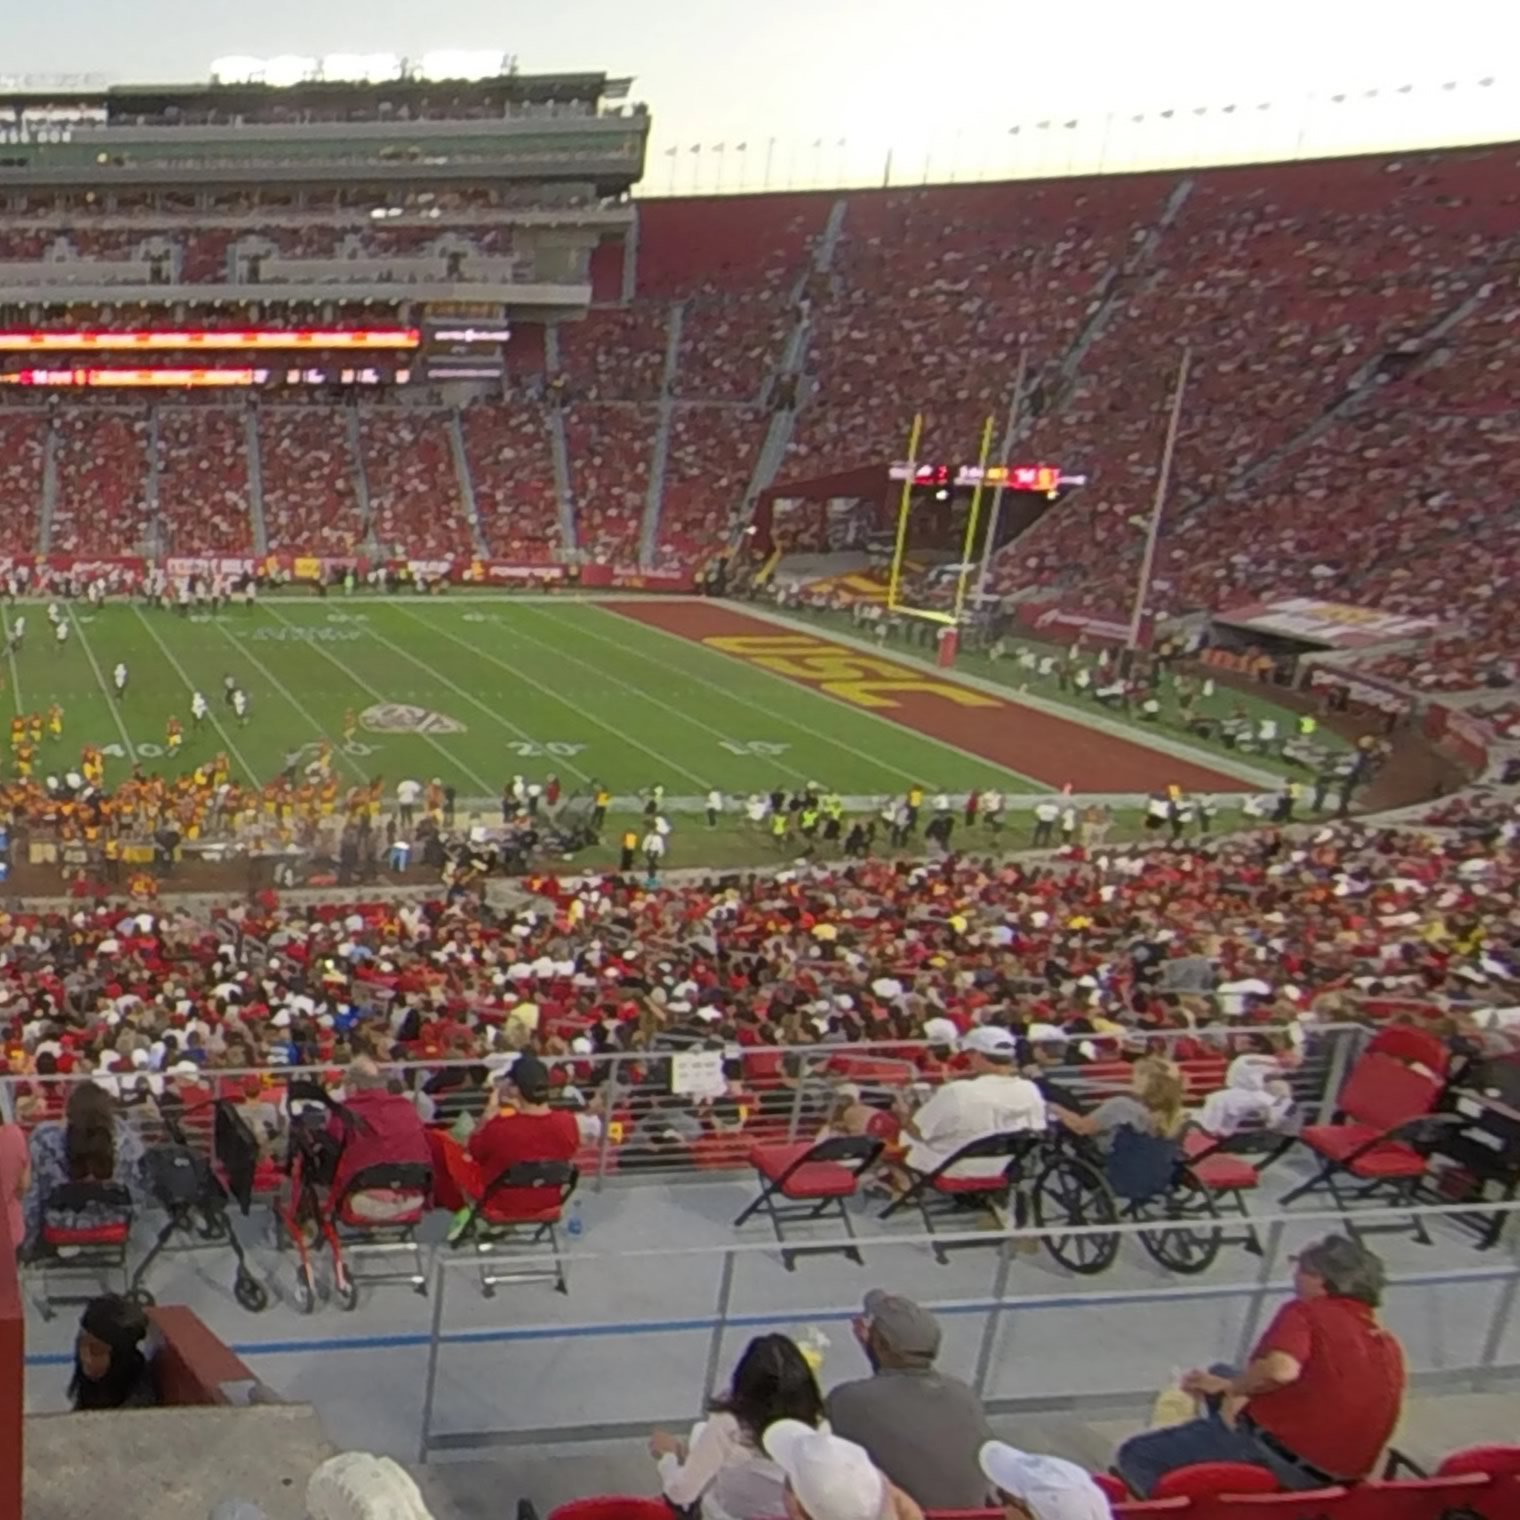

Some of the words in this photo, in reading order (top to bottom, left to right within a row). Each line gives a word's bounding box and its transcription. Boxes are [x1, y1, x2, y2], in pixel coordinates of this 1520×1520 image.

[701, 635, 1005, 707] USC
[101, 742, 163, 758] 40
[506, 741, 578, 756] 20
